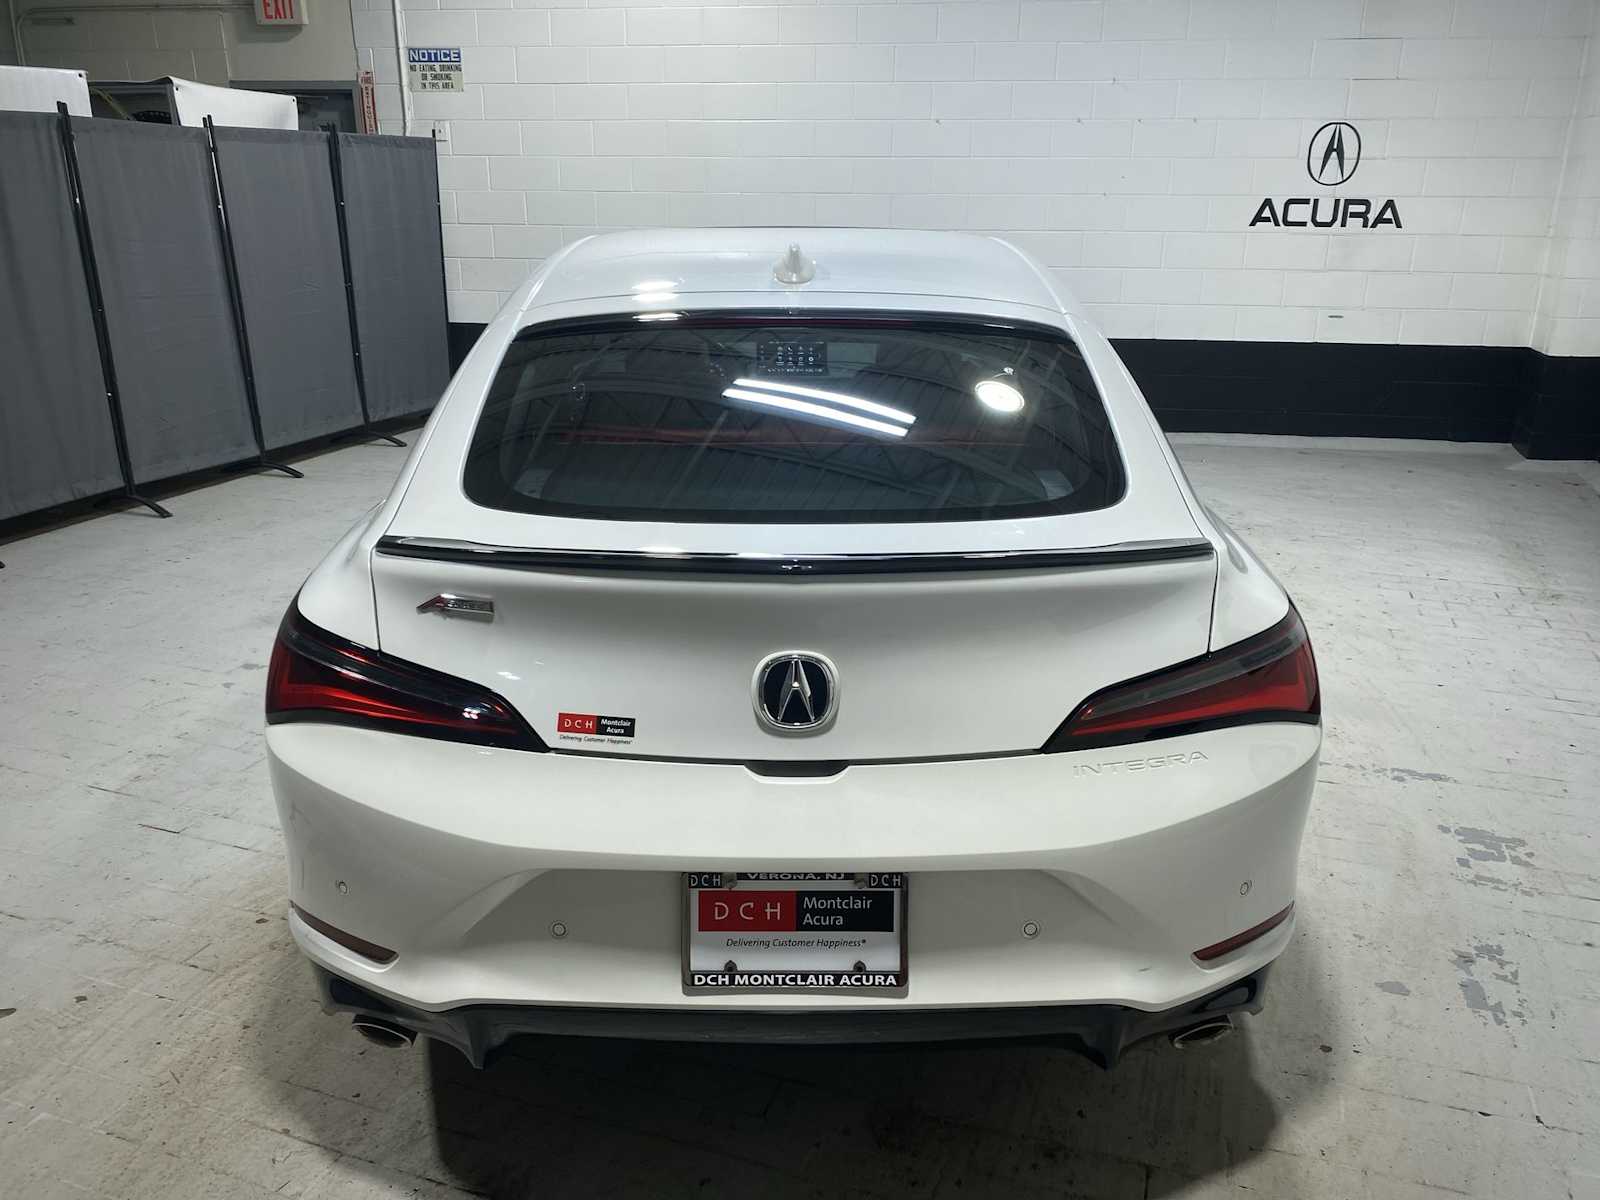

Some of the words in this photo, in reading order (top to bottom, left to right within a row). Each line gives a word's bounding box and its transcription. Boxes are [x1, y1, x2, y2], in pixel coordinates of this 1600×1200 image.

[409, 49, 461, 61] NOTICE
[410, 64, 417, 72] NO
[1249, 198, 1402, 228] ACURA
[600, 718, 632, 727] Montclair
[1072, 751, 1209, 778] INTEGRA
[690, 874, 721, 887] DCH
[870, 874, 901, 887] DCH
[802, 897, 873, 909] Montclair
[714, 902, 781, 921] DCH
[802, 913, 844, 926] Acura
[726, 938, 770, 949] Delivering
[772, 938, 815, 947] Customer
[693, 974, 729, 986] DCH
[734, 974, 834, 986] MONTCLAIR
[839, 974, 897, 986] ACURA
